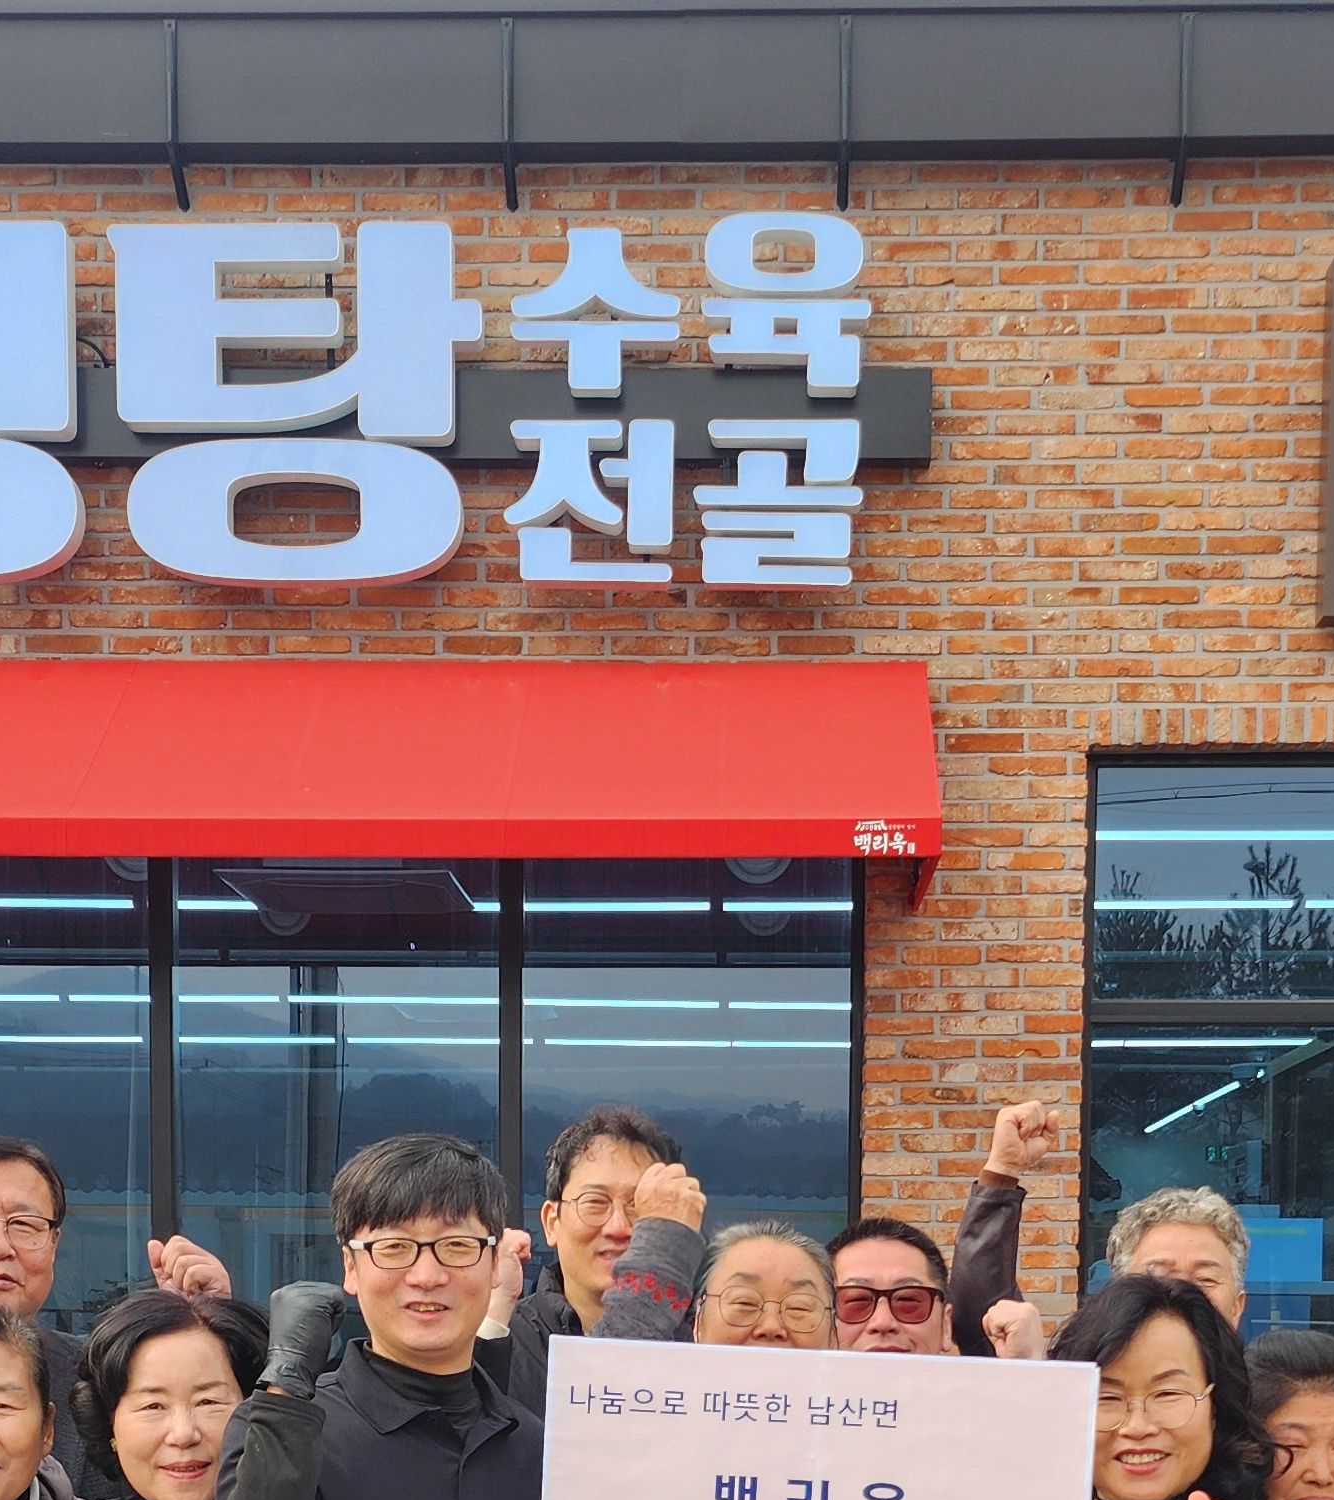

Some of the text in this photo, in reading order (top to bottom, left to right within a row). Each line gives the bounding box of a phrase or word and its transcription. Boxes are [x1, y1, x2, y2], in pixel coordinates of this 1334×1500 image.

[509, 210, 872, 399] 수육
[502, 418, 865, 592] 전골
[853, 832, 908, 856] 백리옥
[568, 1384, 900, 1430] 나눔으로 따뜻한 남산면
